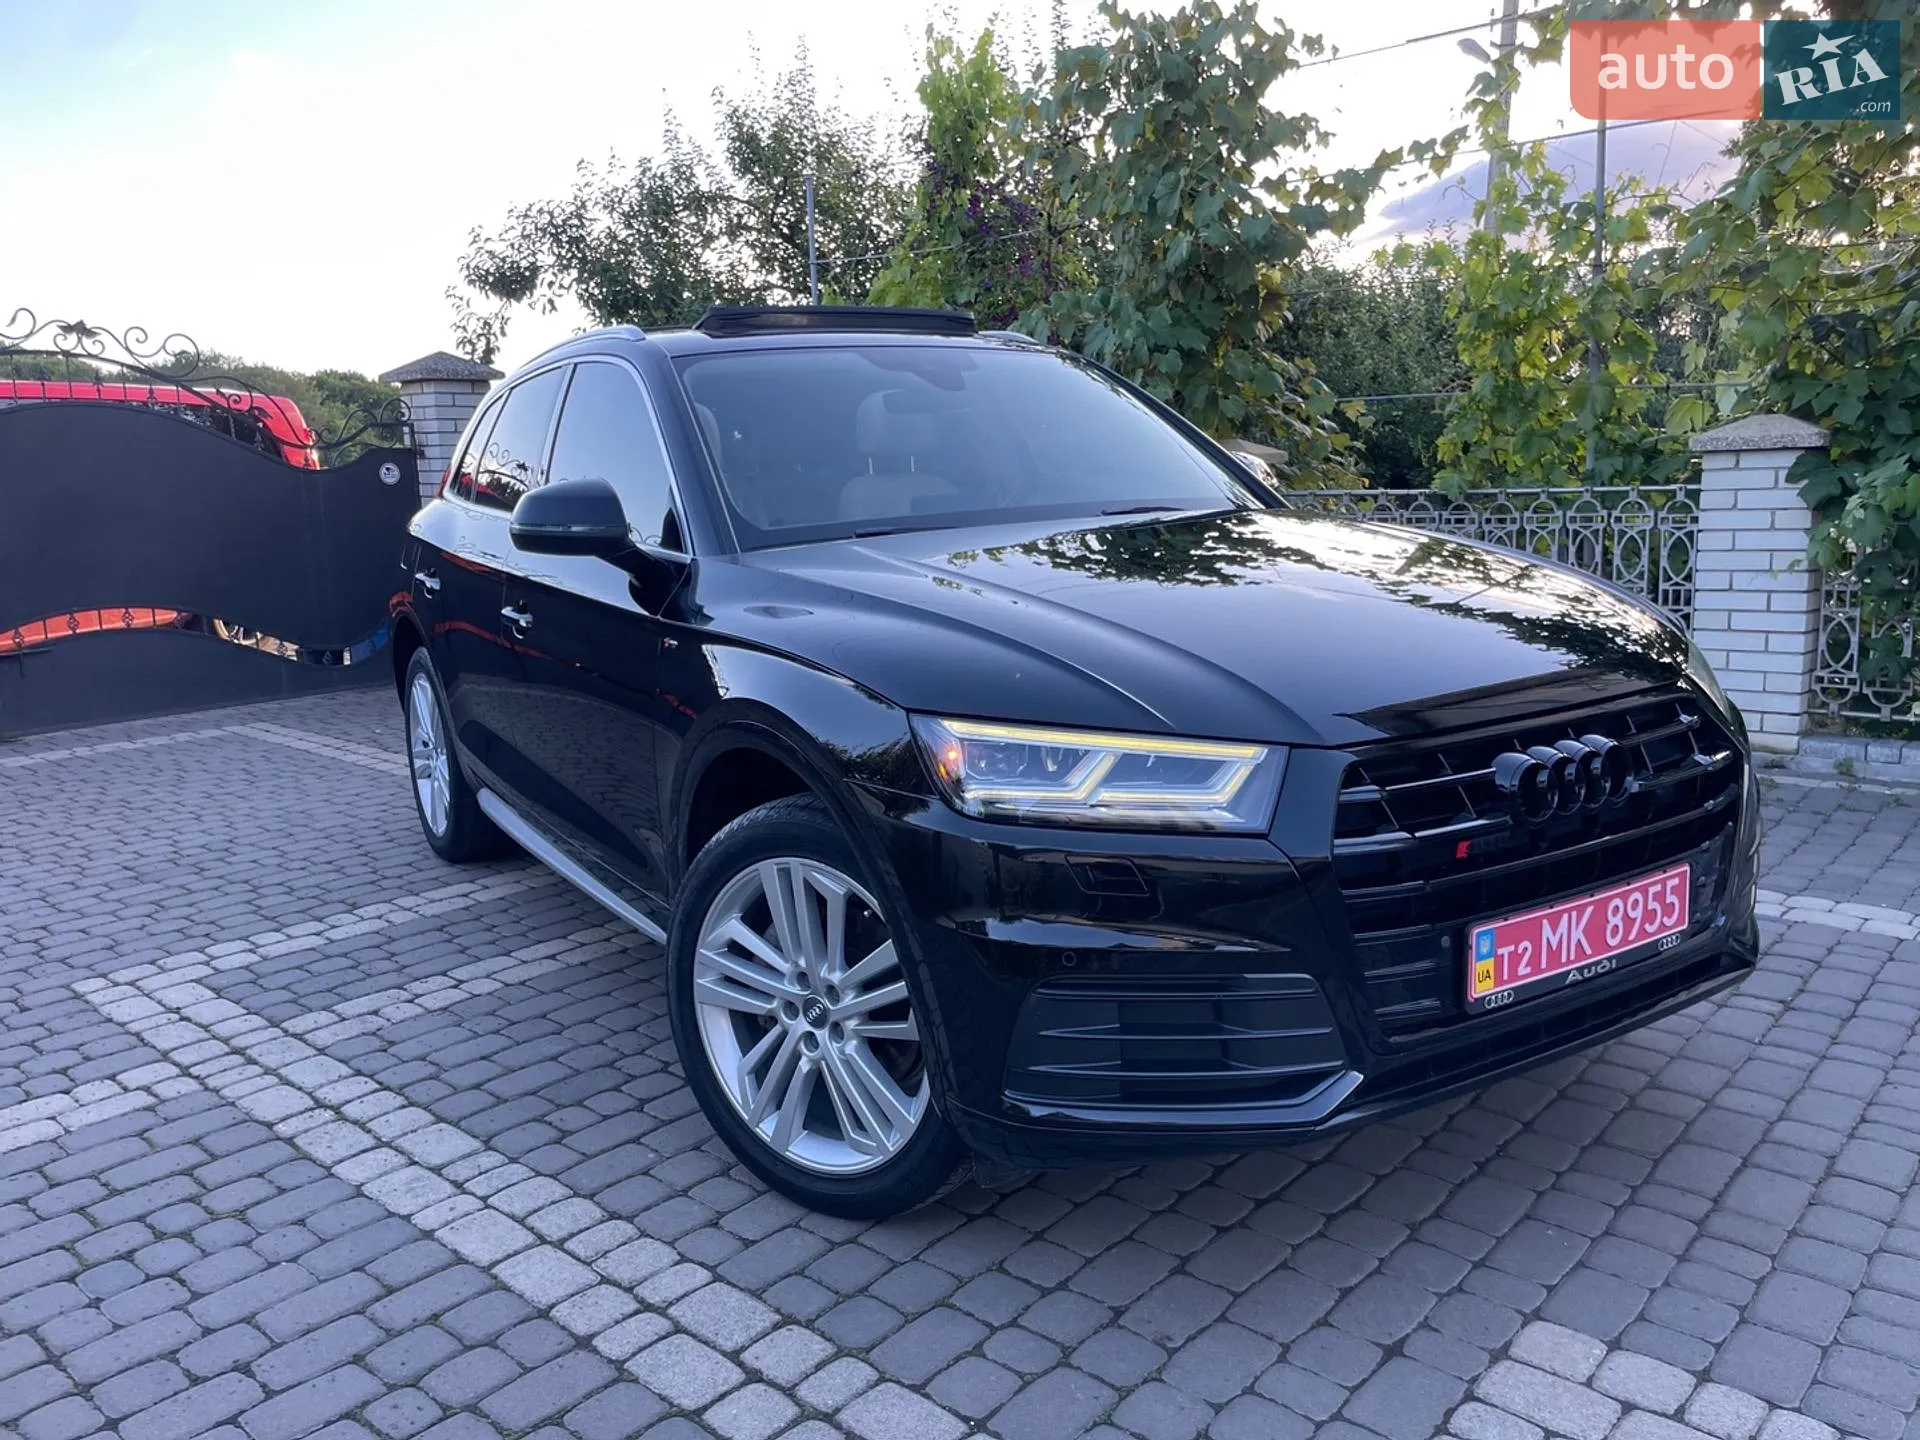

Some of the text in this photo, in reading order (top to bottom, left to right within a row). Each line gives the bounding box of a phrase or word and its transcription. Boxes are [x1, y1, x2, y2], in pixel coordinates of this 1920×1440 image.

[1541, 906, 1594, 969] MK
[1605, 877, 1680, 947] 8955
[1477, 969, 1492, 983] UA
